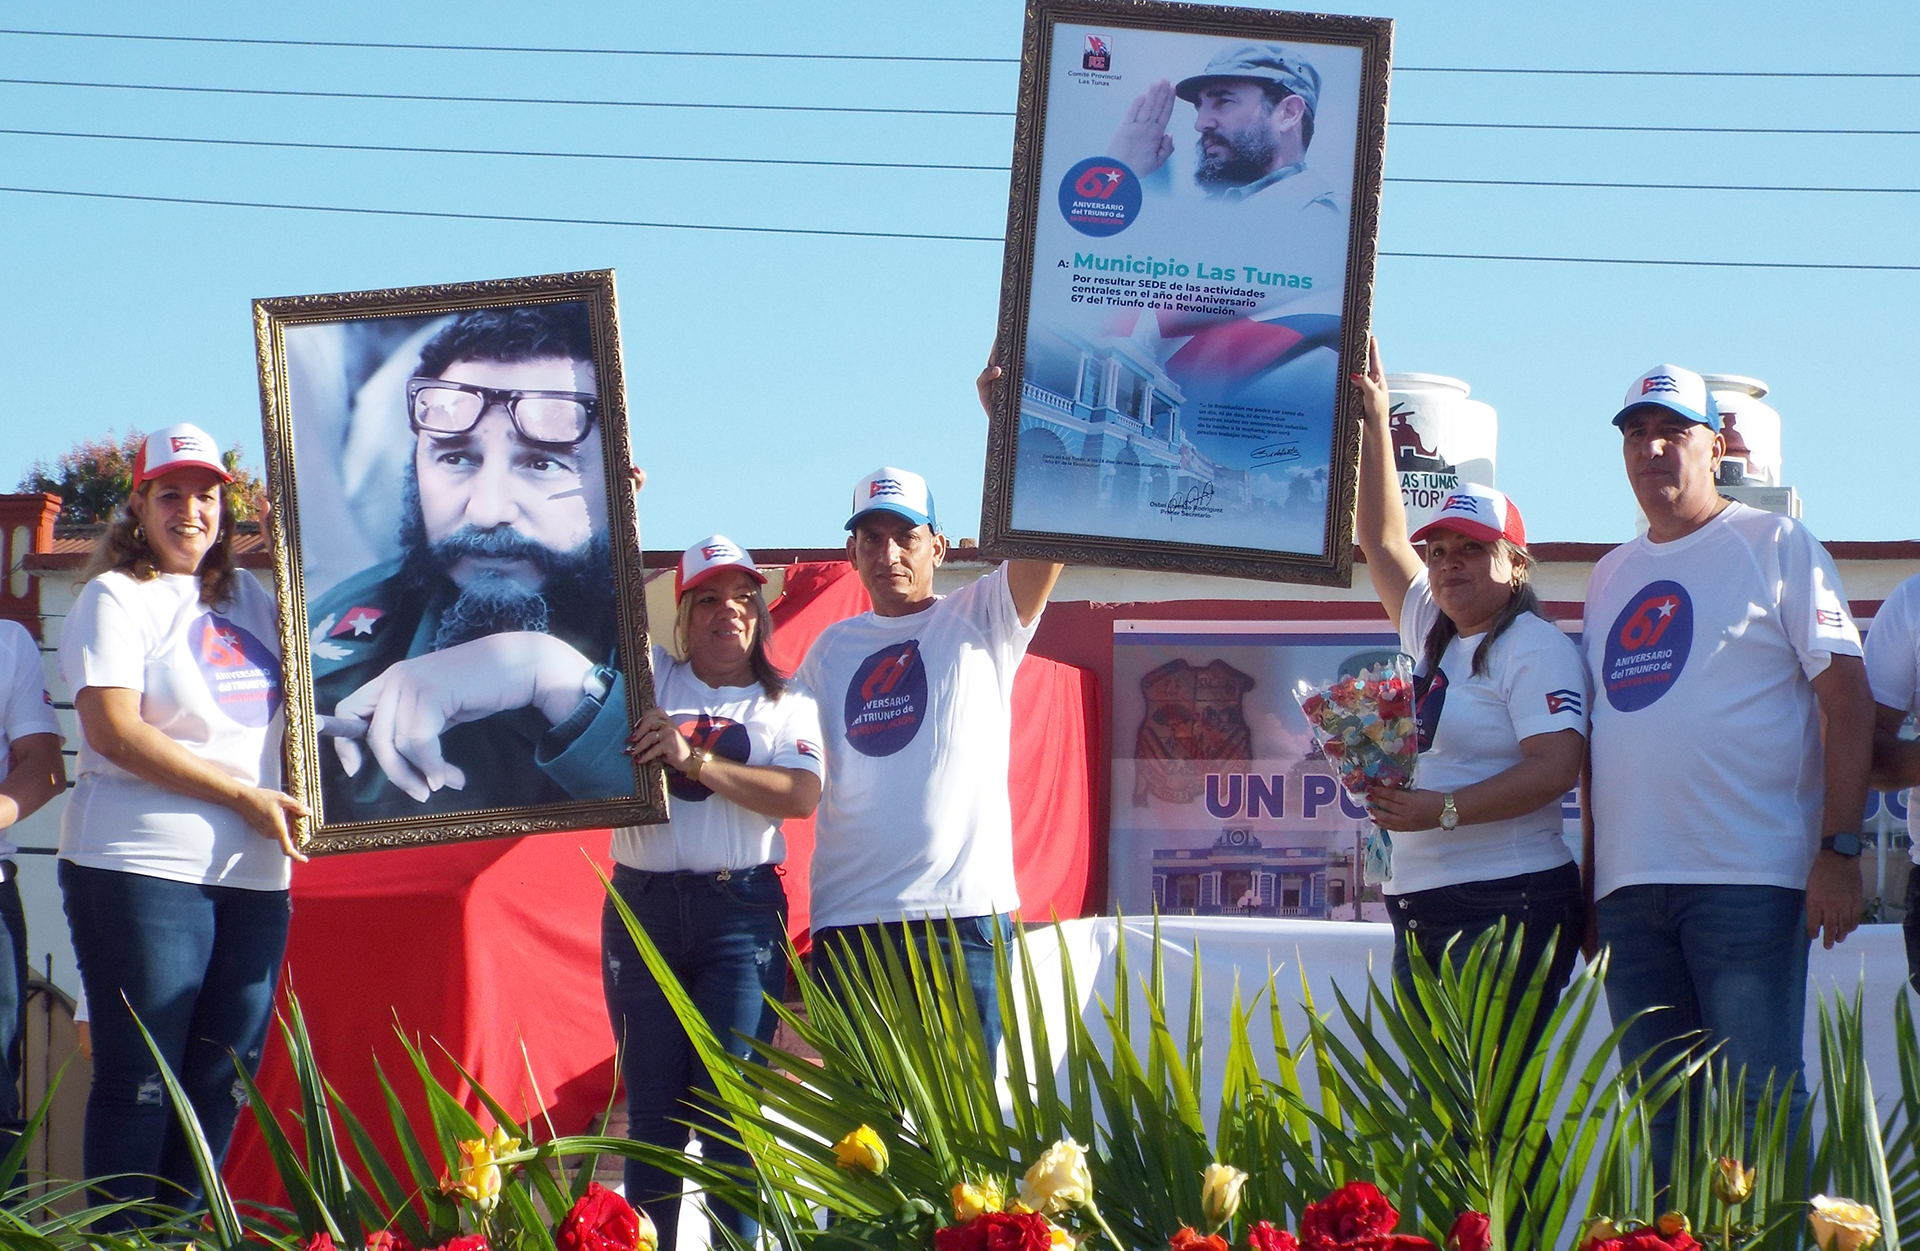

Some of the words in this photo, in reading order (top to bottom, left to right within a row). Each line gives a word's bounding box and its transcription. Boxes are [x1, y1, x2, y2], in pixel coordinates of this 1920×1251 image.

[1091, 72, 1122, 80] Provincial
[1075, 166, 1126, 199] 67
[1072, 201, 1124, 211] ANIVERSARIO
[1084, 209, 1115, 218] TRIUNFO
[1057, 260, 1069, 268] A:
[1074, 252, 1189, 279] Municipio
[1197, 262, 1235, 281] Las
[1243, 266, 1313, 289] Tunas
[1072, 274, 1091, 283] Por
[1094, 277, 1135, 287] resultar
[1138, 279, 1166, 289] SEDE
[1169, 282, 1183, 291] de
[1186, 283, 1200, 292] las
[1204, 286, 1265, 298] actividades
[1072, 285, 1121, 296] centrales
[1124, 289, 1137, 297] en
[1140, 289, 1150, 298] el
[1152, 290, 1173, 301] año
[1175, 293, 1192, 302] del
[1195, 295, 1256, 308] Aniversario
[1071, 295, 1084, 303] 67
[1086, 296, 1103, 304] del
[1106, 297, 1144, 308] Triunfo
[1147, 300, 1160, 309] de
[1163, 302, 1173, 310] la
[1176, 303, 1237, 316] Revolución.
[1214, 403, 1245, 411] Revolución
[1401, 473, 1419, 488] AS
[1421, 474, 1459, 490] TUNAS
[1401, 488, 1444, 508] CTOR
[1181, 510, 1211, 519] Secretario
[1620, 593, 1681, 652] 67
[1615, 649, 1672, 667] ANIVERSARIO
[215, 668, 270, 681] ANIVERSARIO
[1611, 668, 1623, 680] del
[1624, 662, 1660, 677] TRIUNFO
[1661, 661, 1672, 670] de
[218, 683, 232, 692] del
[231, 680, 267, 691] TRIUNFO
[863, 695, 910, 710] VERSARIO
[863, 709, 901, 722] TRIUNFO
[902, 705, 914, 714] de
[1205, 773, 1284, 820] UN
